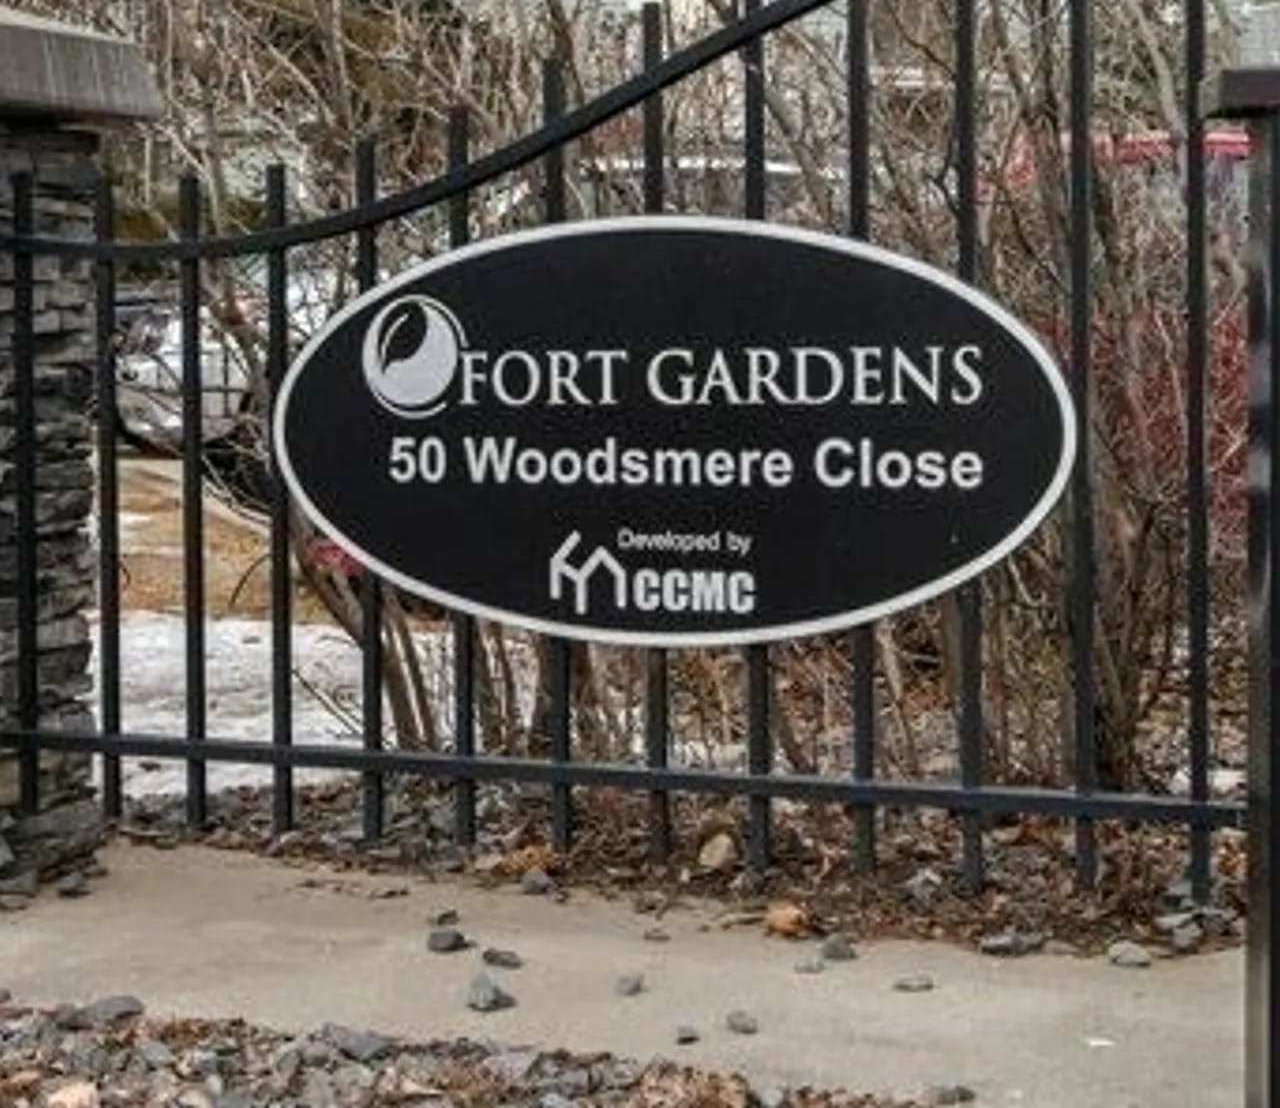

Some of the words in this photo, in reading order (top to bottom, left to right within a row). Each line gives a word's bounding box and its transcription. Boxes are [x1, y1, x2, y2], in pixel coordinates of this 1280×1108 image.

[459, 348, 628, 406] FORT
[648, 345, 983, 406] GARDENS
[389, 436, 447, 483] 50
[464, 436, 794, 487] Woodsmere
[815, 438, 984, 489] Close
[617, 528, 721, 553] Developed
[726, 532, 752, 556] by
[633, 568, 756, 614] CCMC
